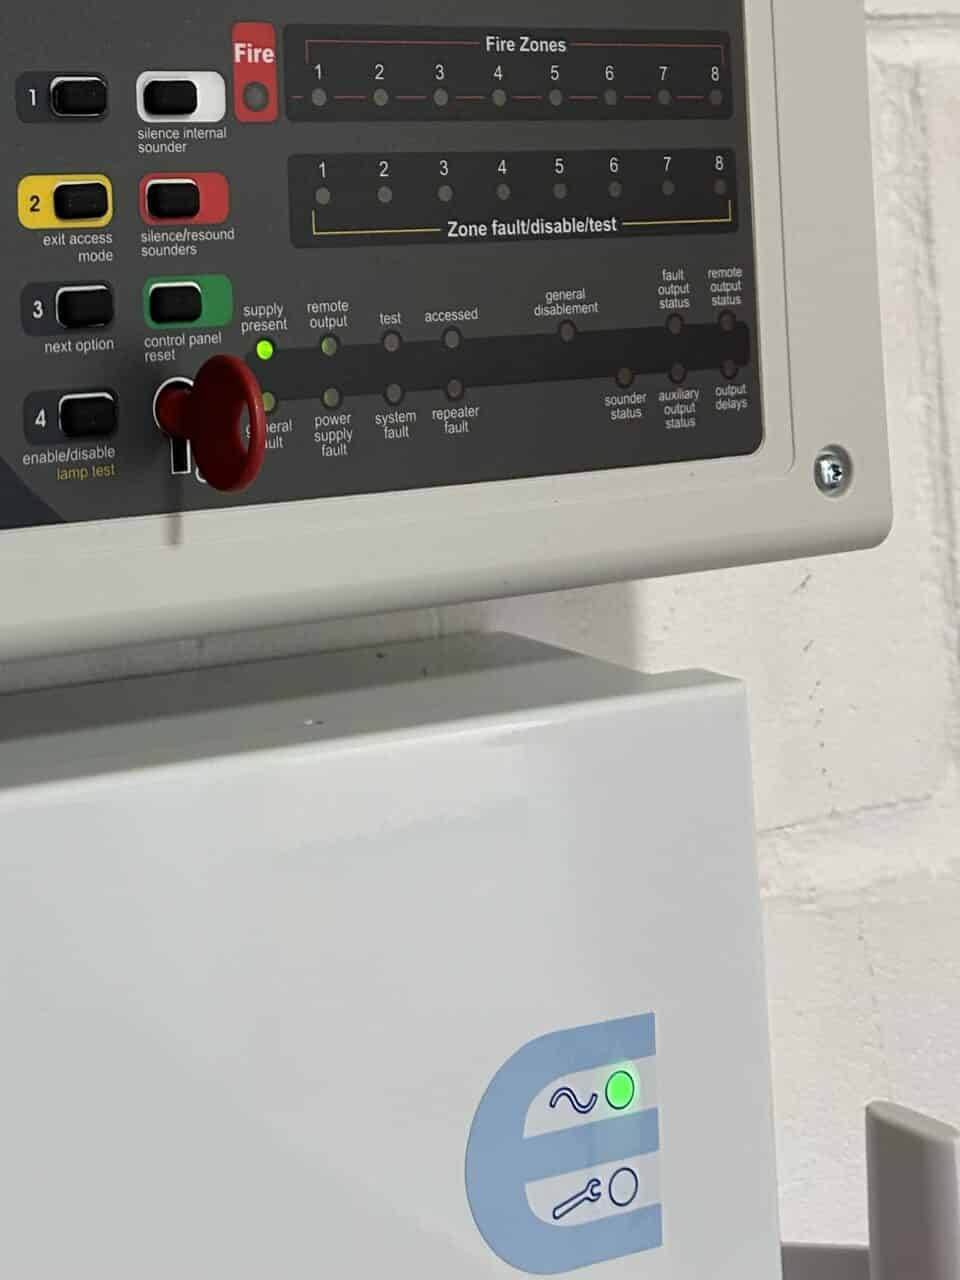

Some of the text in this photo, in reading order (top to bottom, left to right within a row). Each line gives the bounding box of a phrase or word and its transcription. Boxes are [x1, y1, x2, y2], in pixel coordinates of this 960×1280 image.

[486, 35, 567, 54] Fire Zones
[234, 42, 275, 63] Fire
[28, 88, 37, 106] 1
[138, 126, 226, 140] silence internal
[138, 140, 187, 153] sounder
[29, 196, 40, 213] 2
[447, 215, 617, 238] Zone fault/disable/test
[43, 232, 113, 246] exit access
[141, 228, 235, 243] silence/resound
[78, 250, 113, 263] mode
[141, 243, 197, 256] sounders
[663, 269, 684, 281] fault
[546, 288, 585, 304] general
[658, 283, 689, 298] output
[32, 300, 43, 319] 3
[243, 303, 283, 318] supply
[307, 300, 349, 313] remote
[534, 301, 599, 316] disablement
[659, 297, 690, 309] status
[380, 312, 401, 324] test
[424, 308, 479, 322] accessed
[241, 319, 287, 335] present
[310, 316, 347, 330] output
[44, 337, 114, 354] next option
[144, 332, 221, 348] control panel
[144, 349, 175, 362] reset
[35, 409, 46, 427] 4
[22, 445, 115, 465] enable/disable
[57, 464, 114, 482] lamp test
